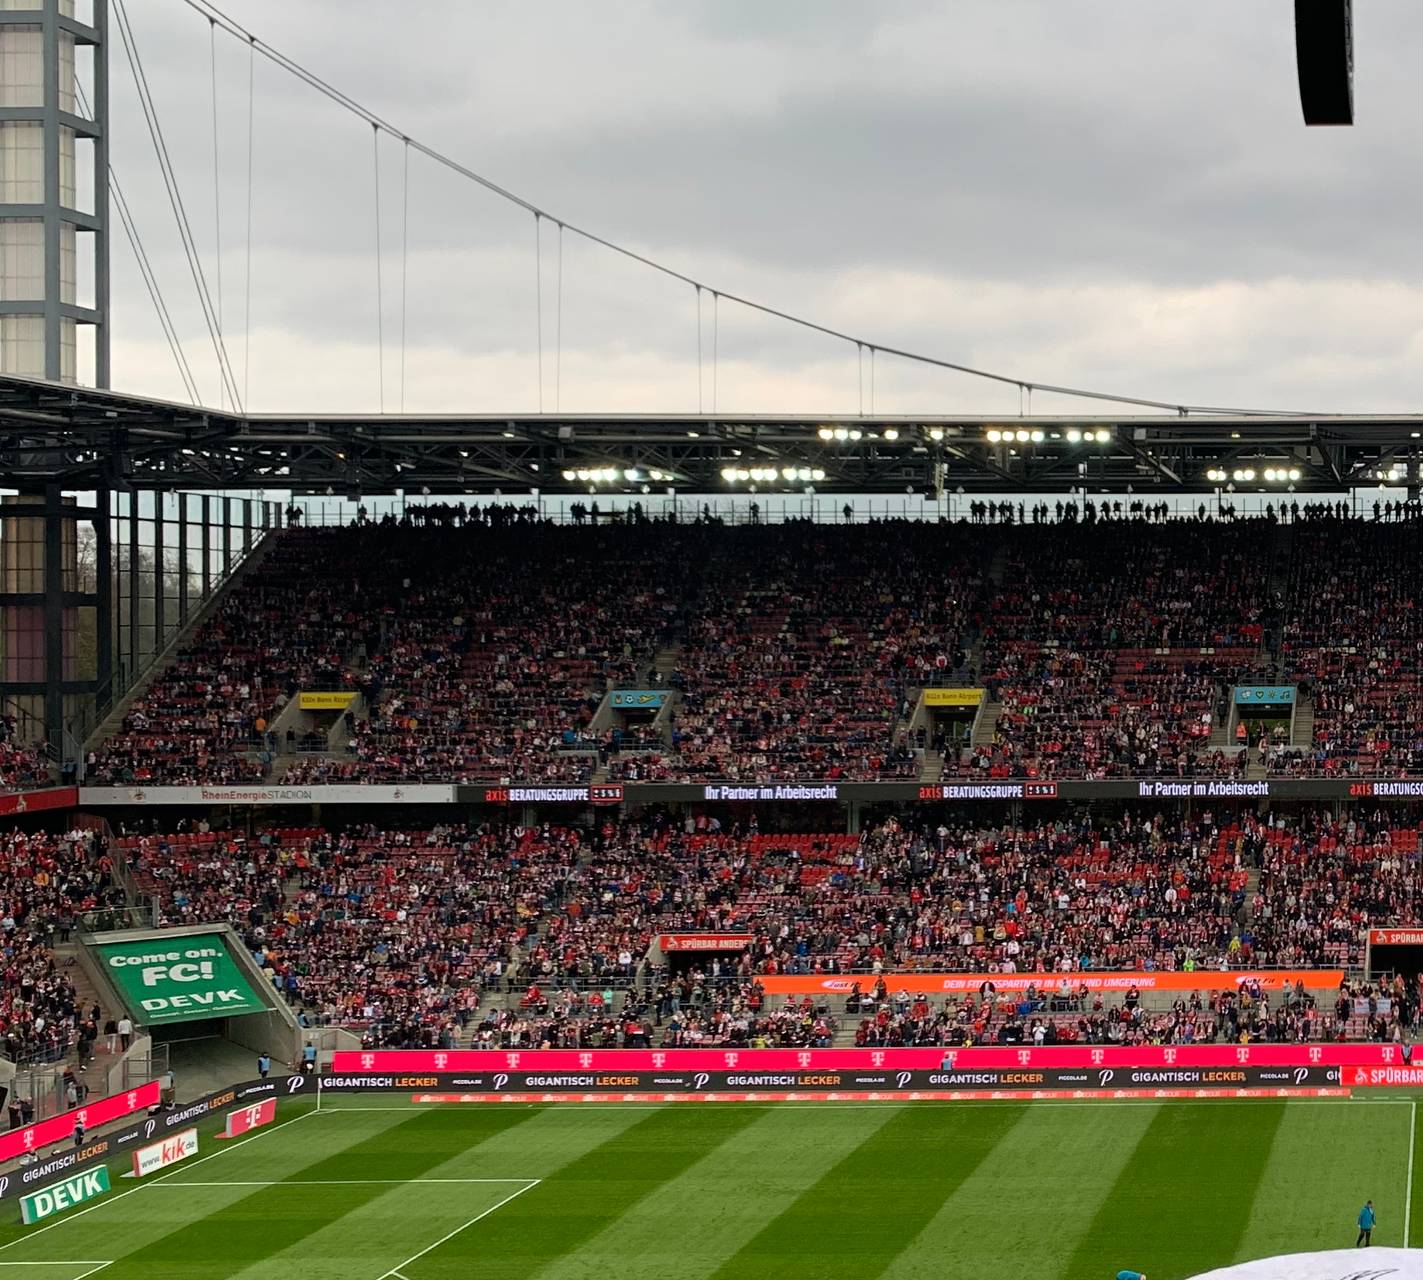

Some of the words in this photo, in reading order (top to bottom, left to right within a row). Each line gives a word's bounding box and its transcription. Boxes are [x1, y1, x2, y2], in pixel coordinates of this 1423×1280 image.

[486, 786, 508, 800] axis
[509, 788, 589, 801] BERATUNGSGRUPPE
[705, 786, 720, 800] Ihr
[721, 786, 758, 800] Partner
[760, 785, 773, 799] im
[775, 785, 838, 799] Arbeitsrecht
[920, 784, 942, 798] axis
[943, 785, 1023, 798] BERATUNGSGRUPPE
[1139, 782, 1154, 796] Ihr
[1155, 782, 1192, 796] Partner
[1193, 781, 1206, 795] im
[1208, 781, 1269, 796] Arbeitsrecht
[1350, 780, 1372, 796] axis
[719, 939, 748, 949] ANDERS
[109, 951, 180, 967] Come
[142, 961, 214, 987] FC!
[1104, 978, 1155, 988] UMGEBUNG
[140, 989, 245, 1011] DEVK
[323, 1077, 393, 1088] GIGANTISCH
[395, 1077, 438, 1087] LECKER
[525, 1076, 594, 1086] GIGANTISCH
[595, 1076, 639, 1086] LECKER
[726, 1075, 795, 1086] GIGANTISCH
[797, 1075, 841, 1085] LECKER
[928, 1074, 998, 1084] GIGANTISCH
[1000, 1073, 1044, 1084] LECKER
[1131, 1072, 1200, 1082] GIGANTISCH
[1202, 1071, 1246, 1082] LECKER
[1371, 1067, 1423, 1083] SPÜRBAR
[166, 1103, 209, 1126] GIGANTISCH
[209, 1091, 235, 1109] LECKER
[246, 1105, 261, 1129] T
[22, 1154, 76, 1183] GIGANTISCH
[76, 1141, 108, 1162] LECKER
[34, 1171, 103, 1218] DEVK
